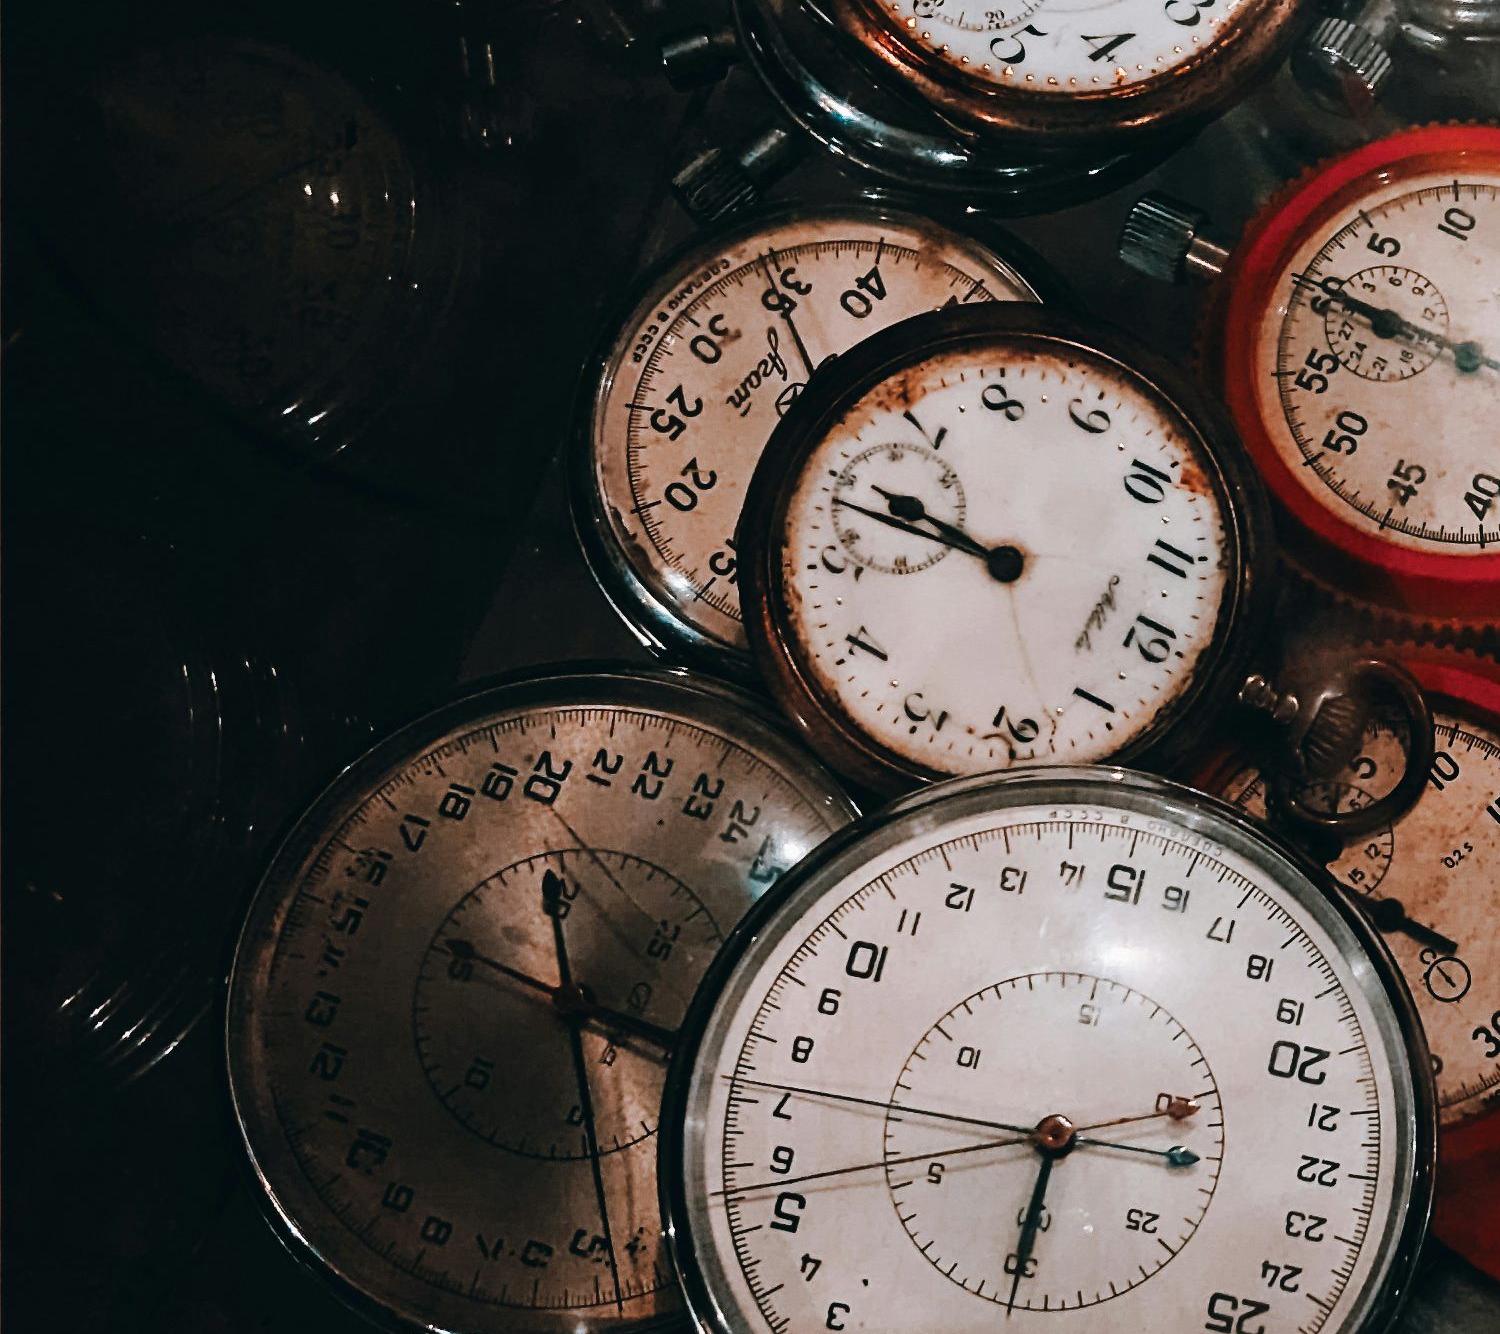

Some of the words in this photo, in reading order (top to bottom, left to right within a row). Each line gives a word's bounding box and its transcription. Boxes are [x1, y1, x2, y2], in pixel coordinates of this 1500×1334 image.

[989, 24, 1048, 64] 5
[1081, 33, 1136, 63] 4
[1438, 207, 1476, 242] 10
[1367, 232, 1401, 258] 5
[761, 268, 812, 318] 35
[839, 267, 888, 319] 40
[1339, 320, 1355, 341] 27
[1421, 305, 1437, 322] 12
[689, 313, 731, 364] 30
[1299, 348, 1340, 395] 55
[1373, 356, 1388, 372] 21
[1400, 349, 1414, 365] 18
[650, 385, 703, 441] 25
[981, 384, 1025, 422] 8
[1068, 398, 1111, 434] 9
[903, 410, 949, 450] 7
[1323, 410, 1369, 455] 50
[664, 457, 718, 512] 20
[1123, 458, 1172, 504] 10
[1387, 459, 1428, 507] 45
[1146, 539, 1195, 579] 11
[844, 625, 888, 662] 4
[1122, 615, 1178, 664] 12
[903, 692, 949, 732] 3
[1072, 687, 1115, 714] 1
[992, 705, 1040, 743] 2
[481, 762, 518, 802] 19
[522, 751, 573, 805] 20
[586, 748, 623, 786] 21
[632, 751, 673, 801] 22
[1428, 750, 1460, 792] 10
[440, 783, 476, 820] 18
[682, 772, 725, 821] 23
[399, 812, 431, 853] 17
[718, 799, 761, 845] 24
[999, 867, 1028, 894] 13
[1059, 859, 1087, 887] 14
[1103, 864, 1146, 907] 15
[944, 882, 976, 911] 12
[1160, 885, 1192, 914] 16
[897, 909, 921, 936] 11
[1206, 916, 1237, 945] 17
[844, 939, 889, 983] 10
[1246, 953, 1274, 983] 18
[817, 987, 841, 1016] 9
[1077, 1002, 1100, 1027] 15
[1275, 997, 1305, 1026] 19
[309, 1043, 348, 1081] 12
[791, 1035, 815, 1063] 8
[955, 1045, 982, 1071] 10
[1267, 1038, 1332, 1087] 20
[773, 1092, 793, 1121] 7
[1307, 1101, 1342, 1132] 21
[768, 1145, 796, 1174] 6
[927, 1161, 947, 1186] 5
[1295, 1154, 1341, 1187] 22
[421, 1216, 452, 1245] 8
[769, 1191, 808, 1234] 5
[1125, 1206, 1161, 1234] 25
[1285, 1209, 1330, 1244] 23
[800, 1252, 824, 1283] 4
[1260, 1258, 1305, 1294] 24
[825, 1301, 851, 1332] 3
